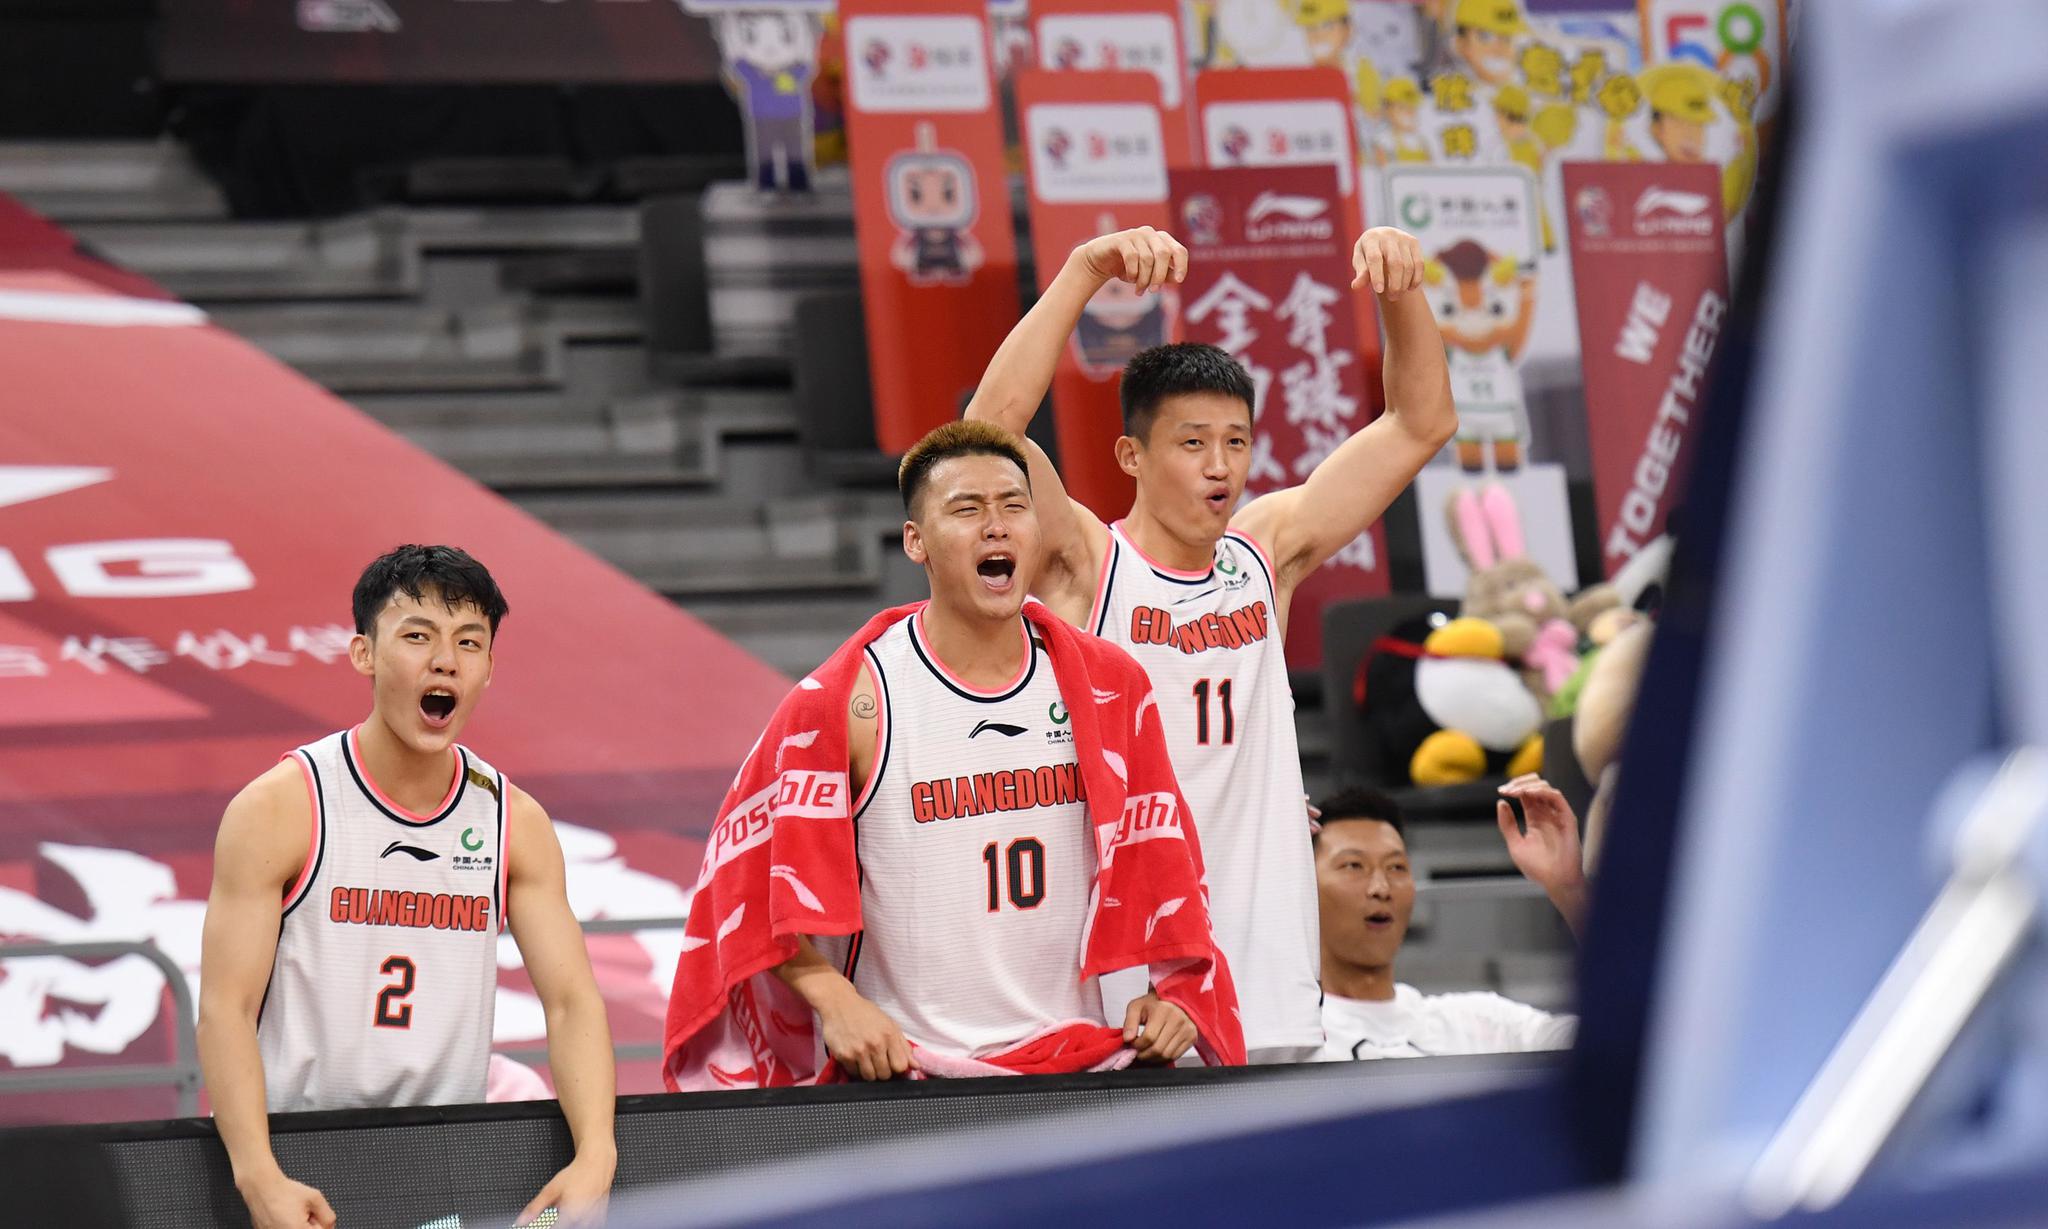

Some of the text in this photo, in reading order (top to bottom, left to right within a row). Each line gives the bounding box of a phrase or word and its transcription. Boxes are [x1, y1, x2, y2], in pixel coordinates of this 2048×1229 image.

[1614, 280, 1672, 364] WE
[1606, 288, 1729, 559] TOGETHER
[1046, 730, 1071, 739] 中国人
[1192, 678, 1234, 745] 11
[453, 856, 492, 865] 中国人寿
[982, 836, 1046, 913] 10
[330, 886, 490, 932] GUANGDONG
[373, 955, 417, 1030] 2
